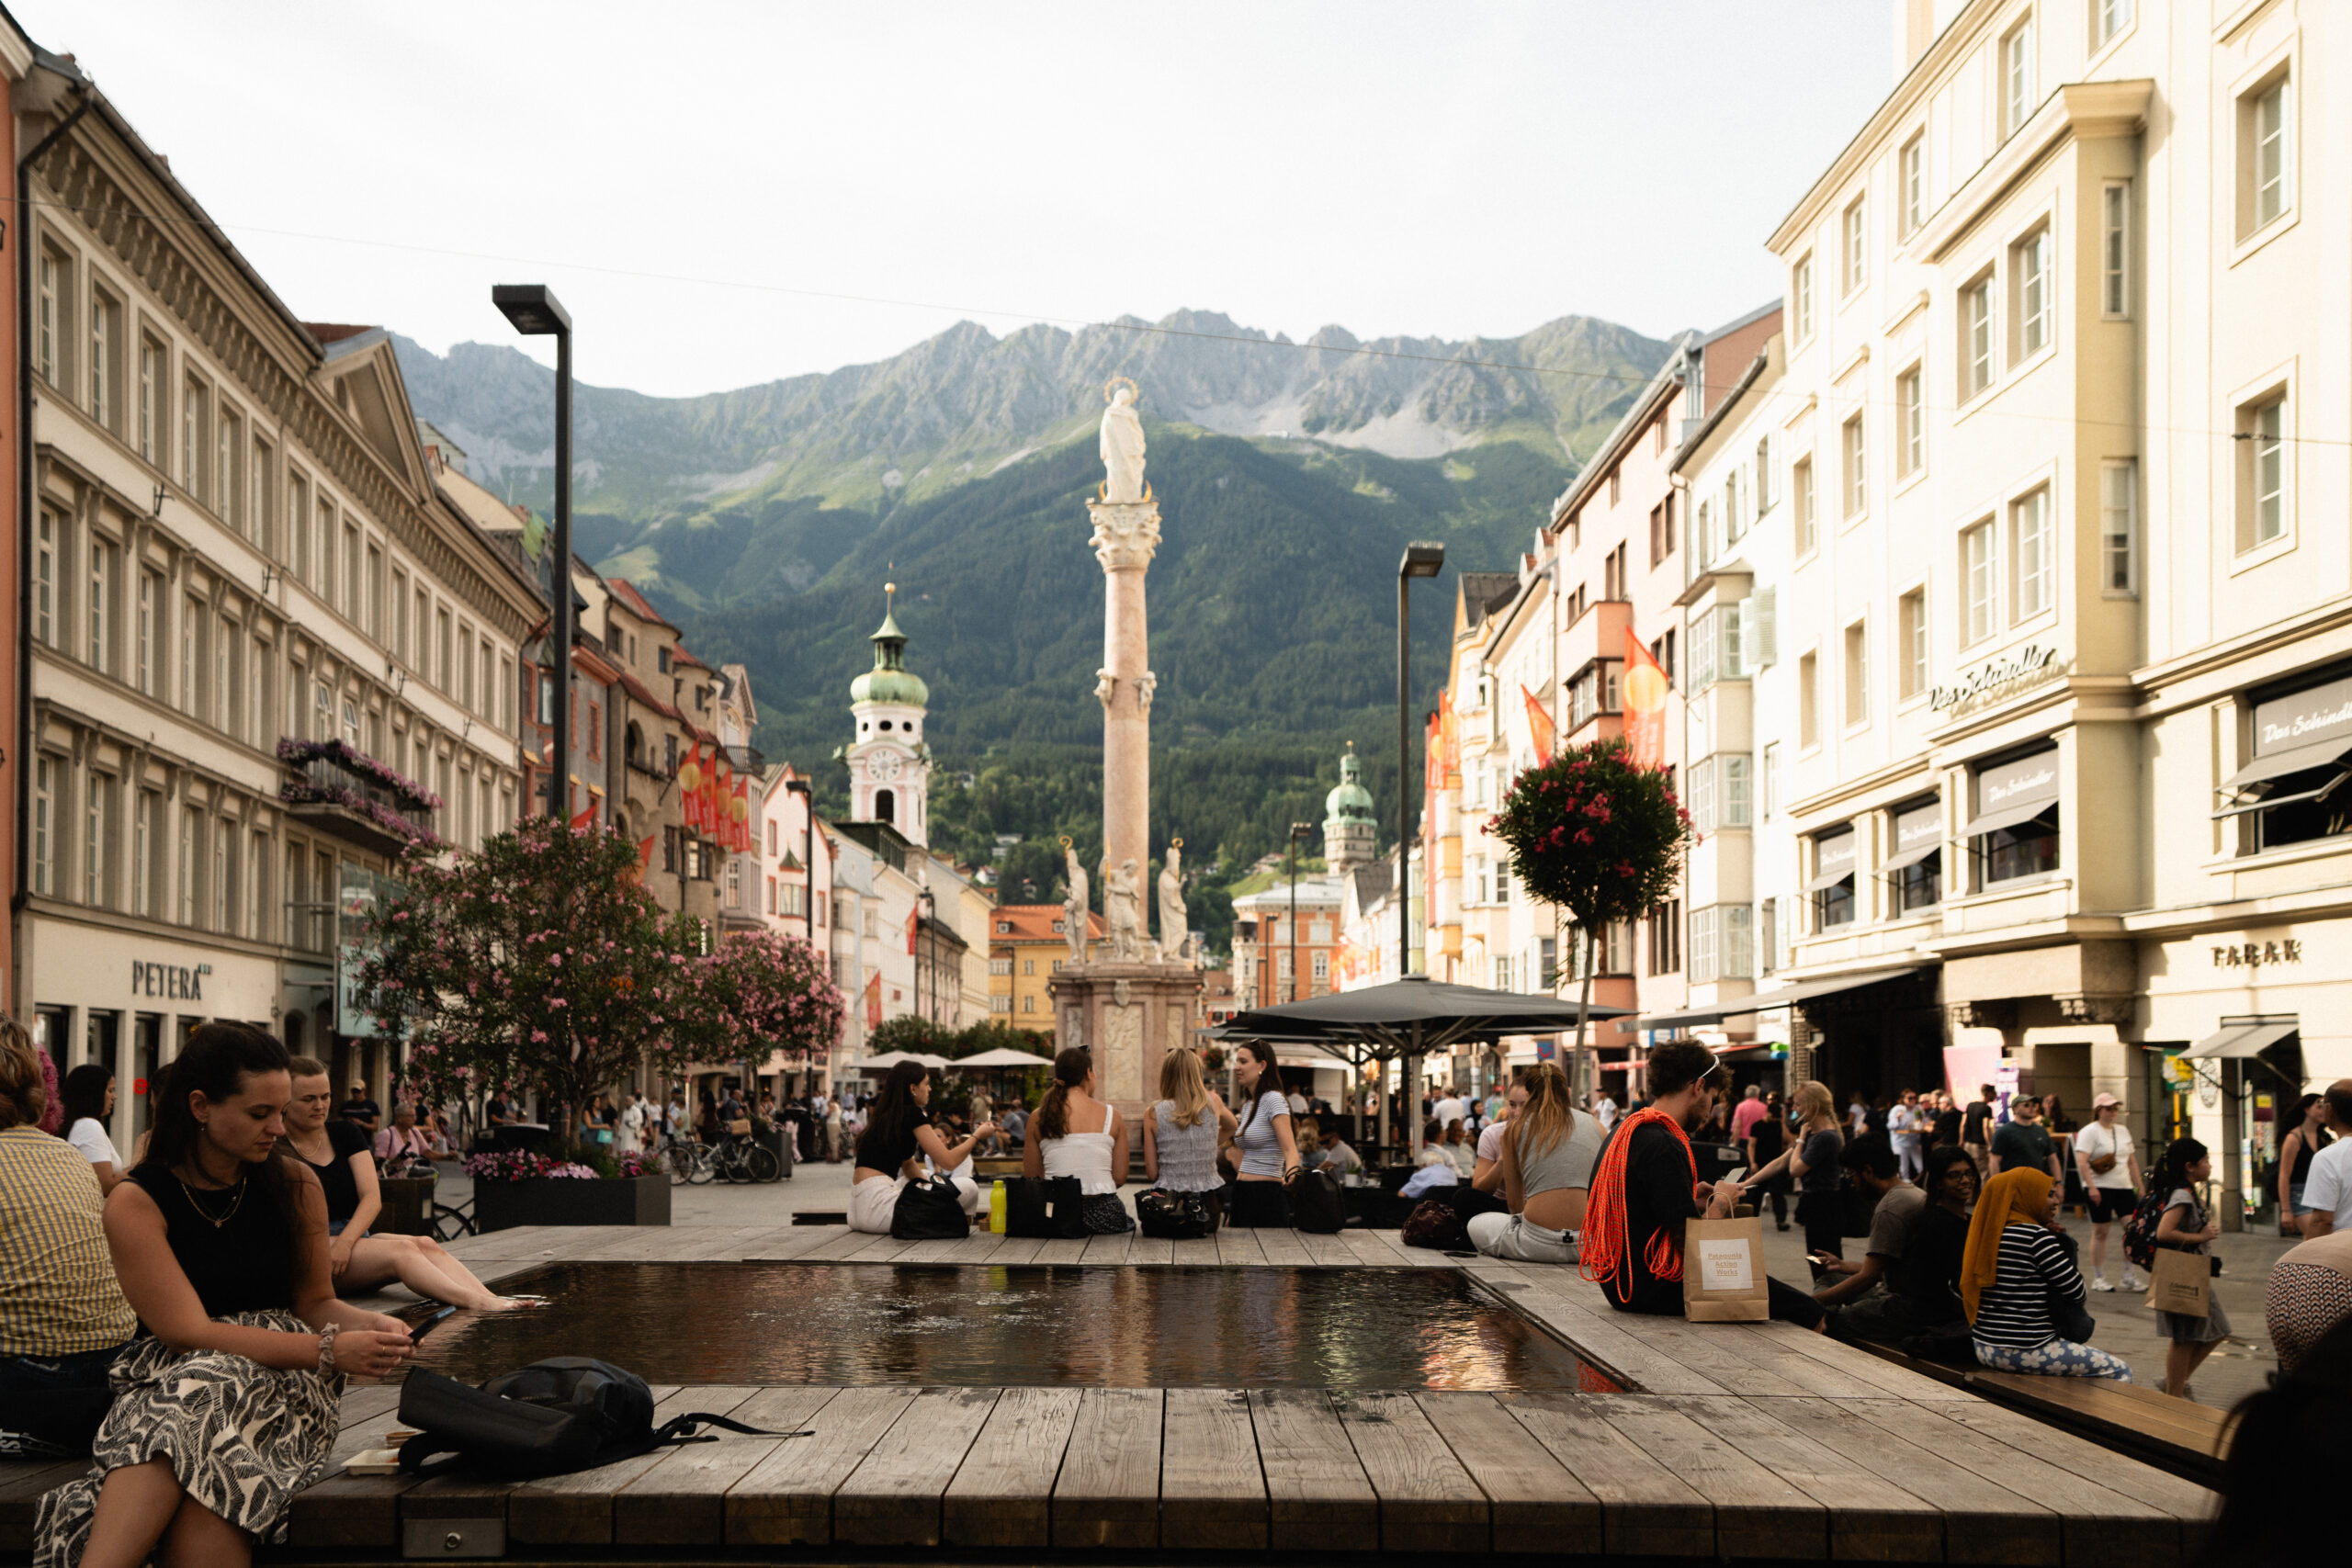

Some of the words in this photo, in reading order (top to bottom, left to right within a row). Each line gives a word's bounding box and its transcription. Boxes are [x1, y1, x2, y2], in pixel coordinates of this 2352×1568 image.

[2263, 723, 2290, 744] Das
[2211, 940, 2301, 967] TABAK
[132, 959, 201, 1000] PETERA
